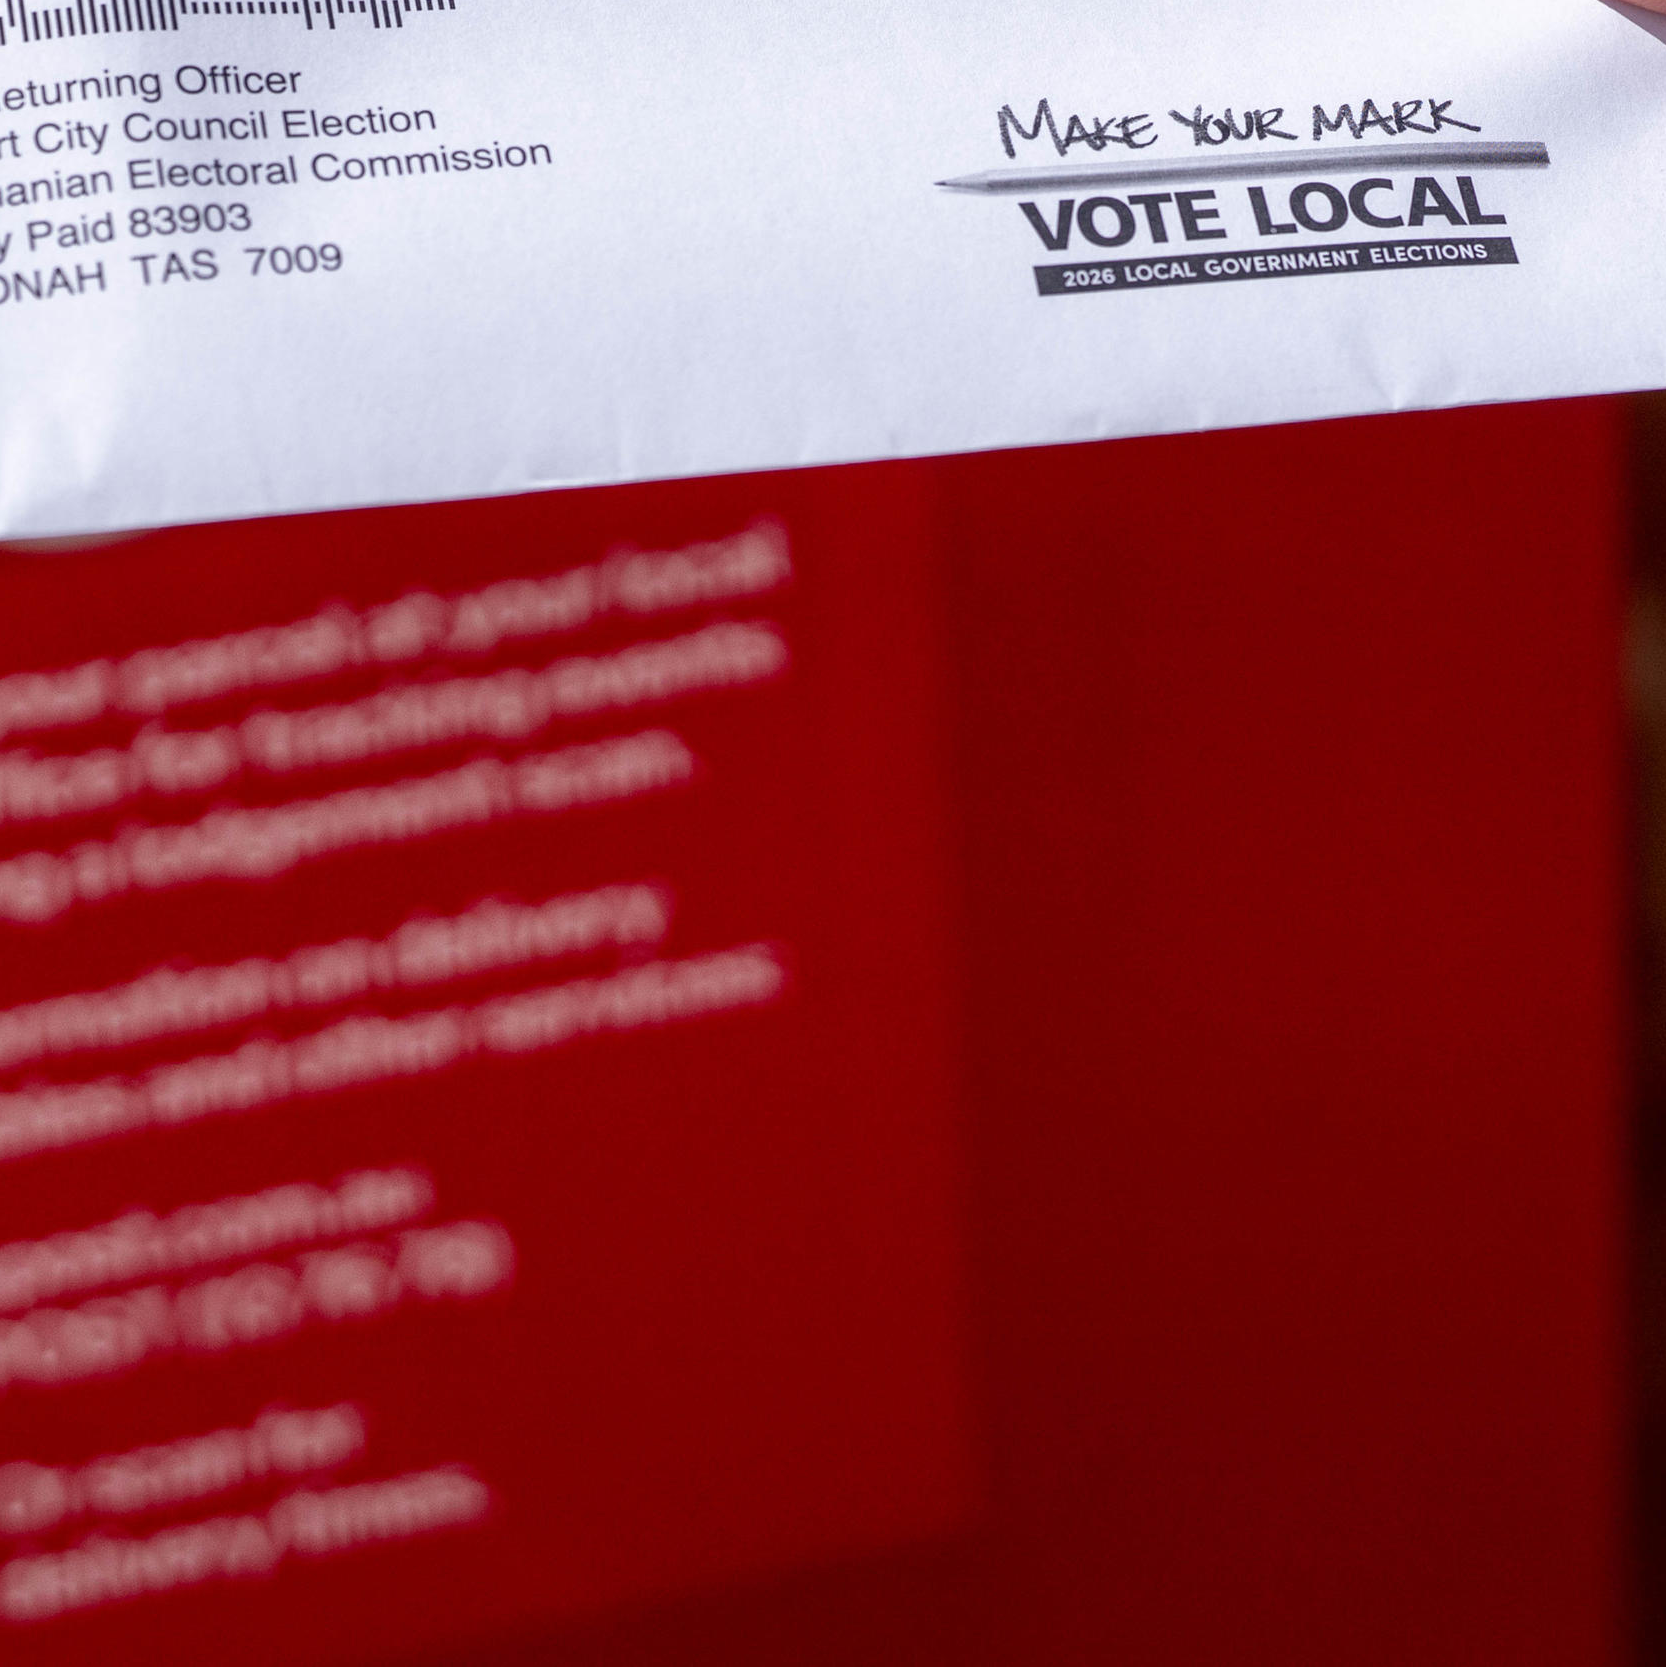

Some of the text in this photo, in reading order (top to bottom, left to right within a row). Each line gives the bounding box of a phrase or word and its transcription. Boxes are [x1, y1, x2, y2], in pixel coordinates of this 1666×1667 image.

[175, 65, 302, 95] Officer
[33, 121, 109, 156] City
[123, 110, 268, 143] Council
[281, 108, 436, 139] Election
[997, 97, 1482, 159] MAKE YOUR MARK
[127, 155, 298, 190] Electoral
[310, 143, 552, 182] Commission
[26, 211, 115, 252] Paid
[129, 202, 252, 238] 83903
[1018, 175, 1508, 252] VOTE LOCAL
[131, 248, 220, 285] TAS
[244, 243, 343, 276] 7009
[1062, 242, 1490, 290] 2026 LOCAL GOVERNMENT ELECTIONS
